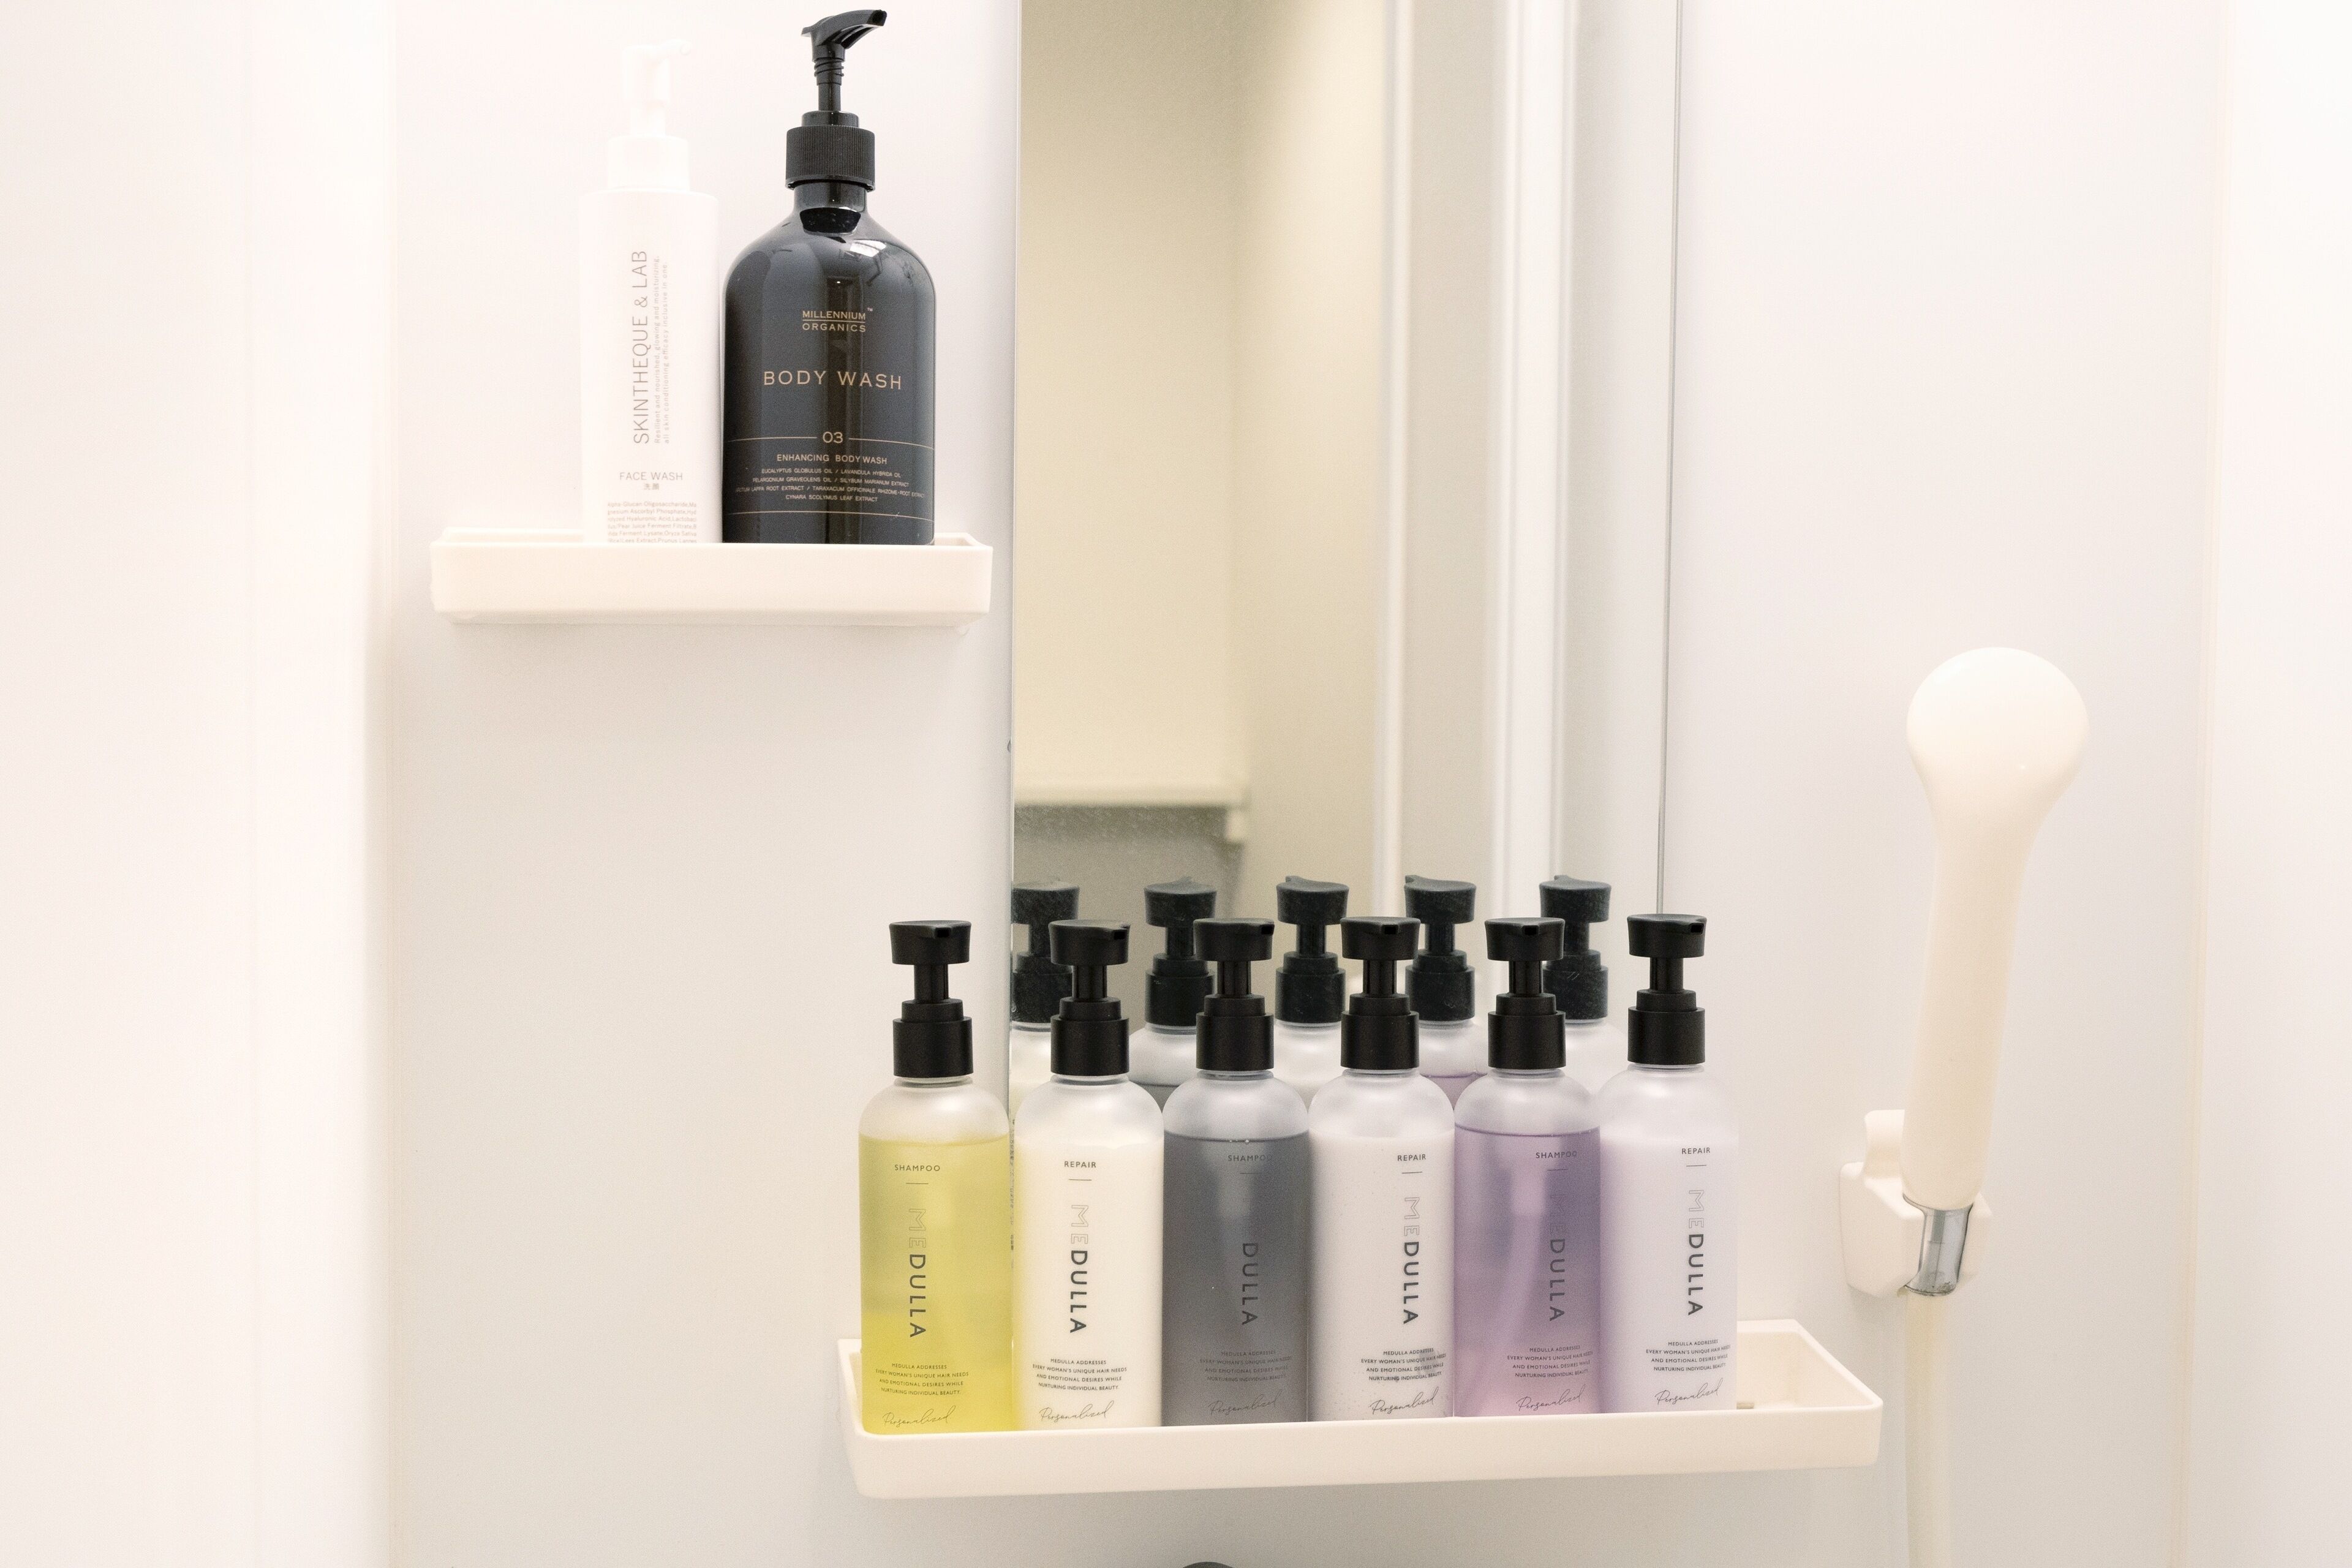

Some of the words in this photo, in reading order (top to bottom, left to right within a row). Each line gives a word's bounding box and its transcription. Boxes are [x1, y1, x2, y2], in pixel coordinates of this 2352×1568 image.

[631, 251, 647, 288] LAB
[634, 296, 647, 307] &
[802, 310, 866, 320] MILLENNIUM
[802, 323, 866, 333] ORGANICS
[632, 316, 651, 444] SKINTHEQUE
[764, 371, 826, 385] BODY
[837, 371, 901, 390] WASH
[823, 431, 843, 443] 03
[862, 456, 887, 465] WASH
[619, 471, 647, 481] FACE
[650, 472, 683, 481] WASH
[1535, 1150, 1578, 1159] SHAMPOO
[1403, 1196, 1420, 1324] MEDULLA
[1687, 1189, 1705, 1316] MEDULLA
[908, 1208, 927, 1338] MEDULLA
[1070, 1204, 1089, 1333] MEDULLA
[1039, 1400, 1115, 1423] Personalized
